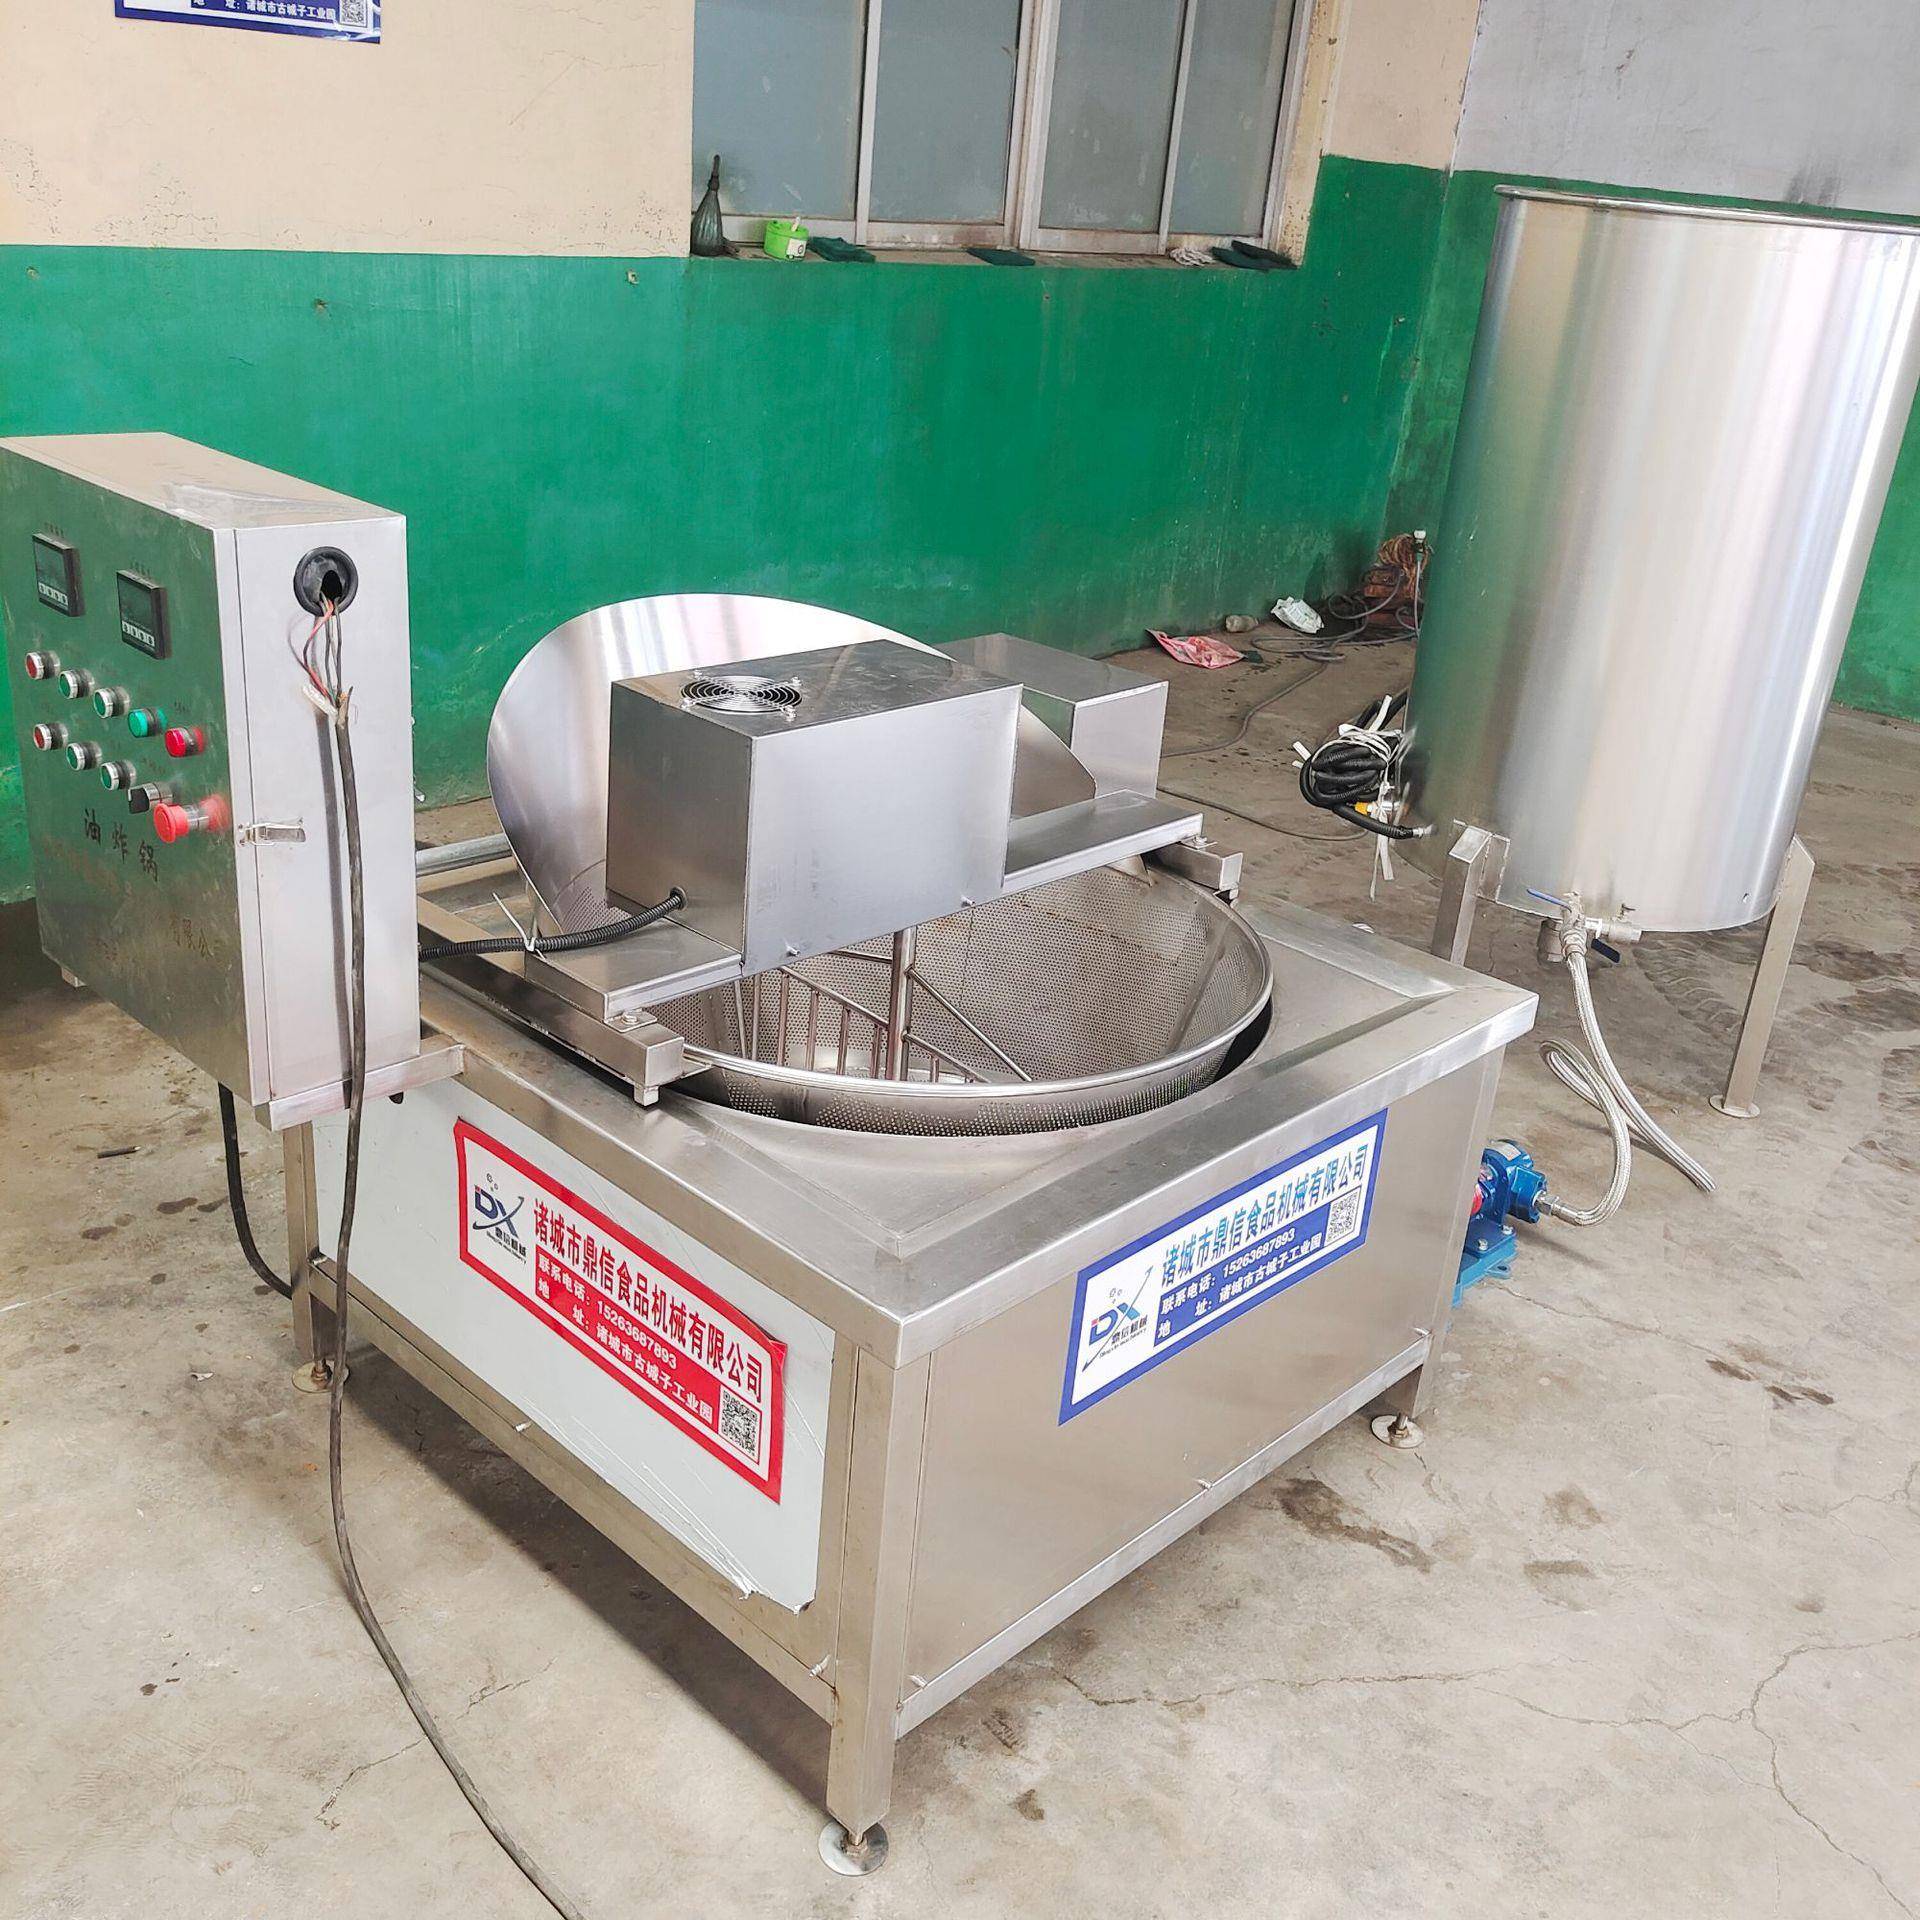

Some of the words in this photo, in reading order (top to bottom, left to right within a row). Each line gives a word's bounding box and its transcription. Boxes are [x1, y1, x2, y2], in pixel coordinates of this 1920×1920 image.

[84, 808, 158, 883] 油炸锅
[1161, 1144, 1369, 1288] 诸城市鼎信食品机械有限公司
[1222, 1227, 1296, 1279] 15263687893
[533, 1197, 762, 1404] 诸城市鼎信食品机械有限公司
[1218, 1232, 1324, 1304] 诸城市古城子工业园
[597, 1299, 678, 1370] 15263687893
[595, 1322, 714, 1424] 诸城市古城子工业园
